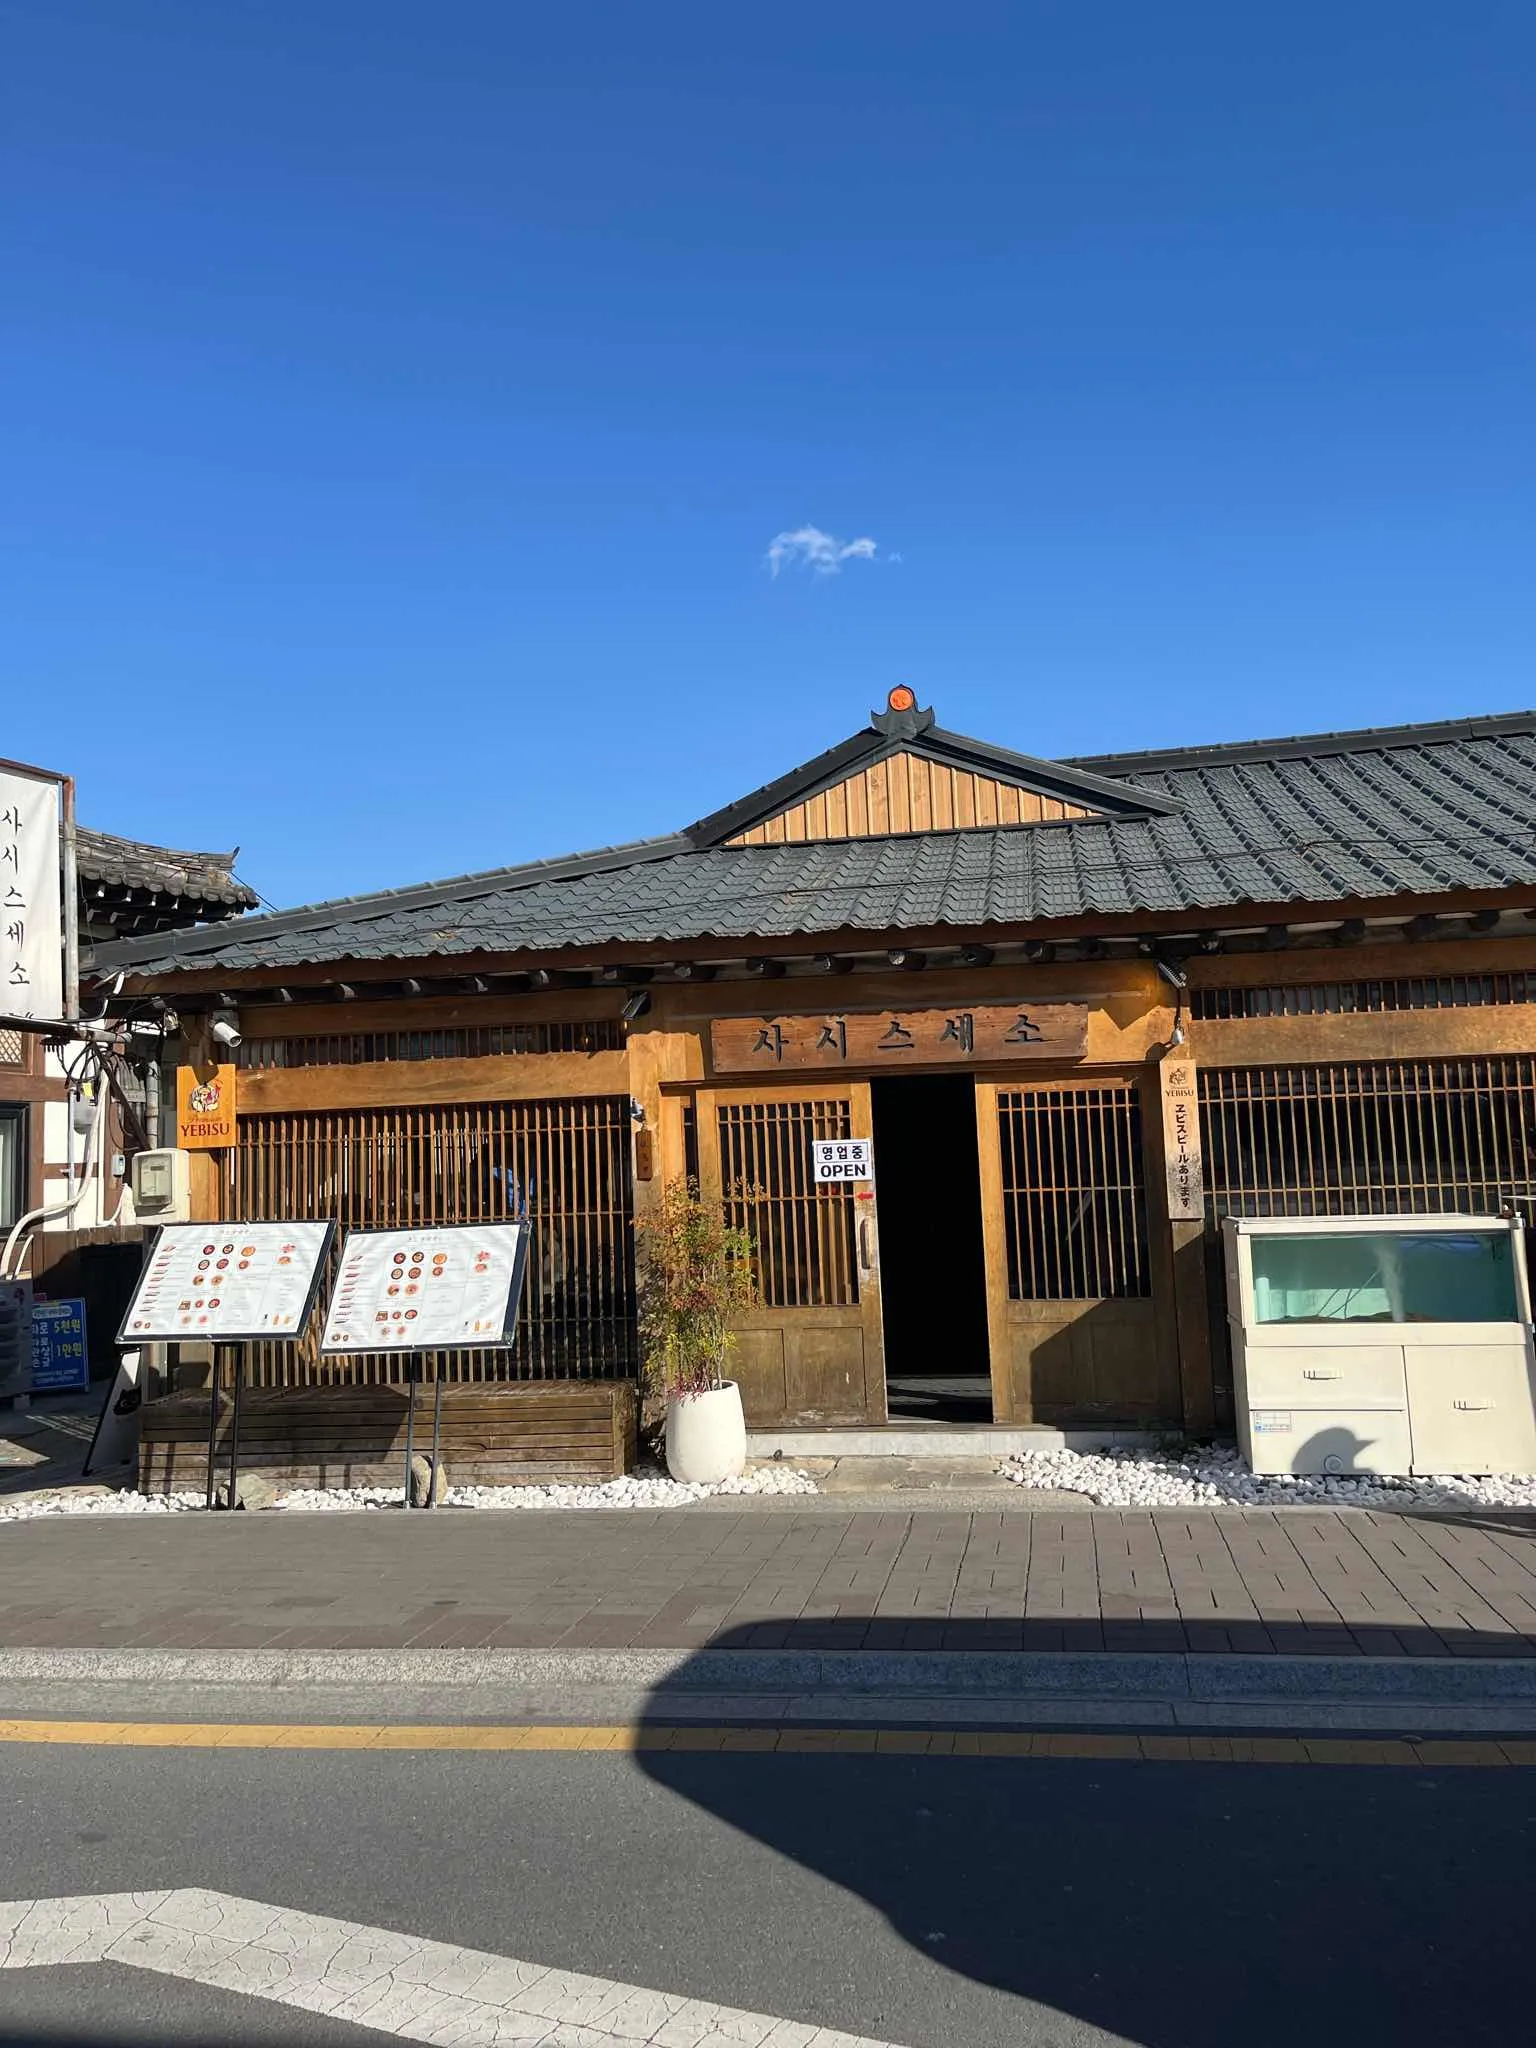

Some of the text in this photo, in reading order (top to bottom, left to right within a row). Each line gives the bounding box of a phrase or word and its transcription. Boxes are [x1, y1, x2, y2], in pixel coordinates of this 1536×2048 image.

[1, 805, 30, 986] 사시스세소
[752, 1013, 1044, 1062] 사시스세소
[180, 1122, 230, 1137] YEBISU
[822, 1145, 863, 1160] 영업중
[820, 1163, 866, 1178] OPEN
